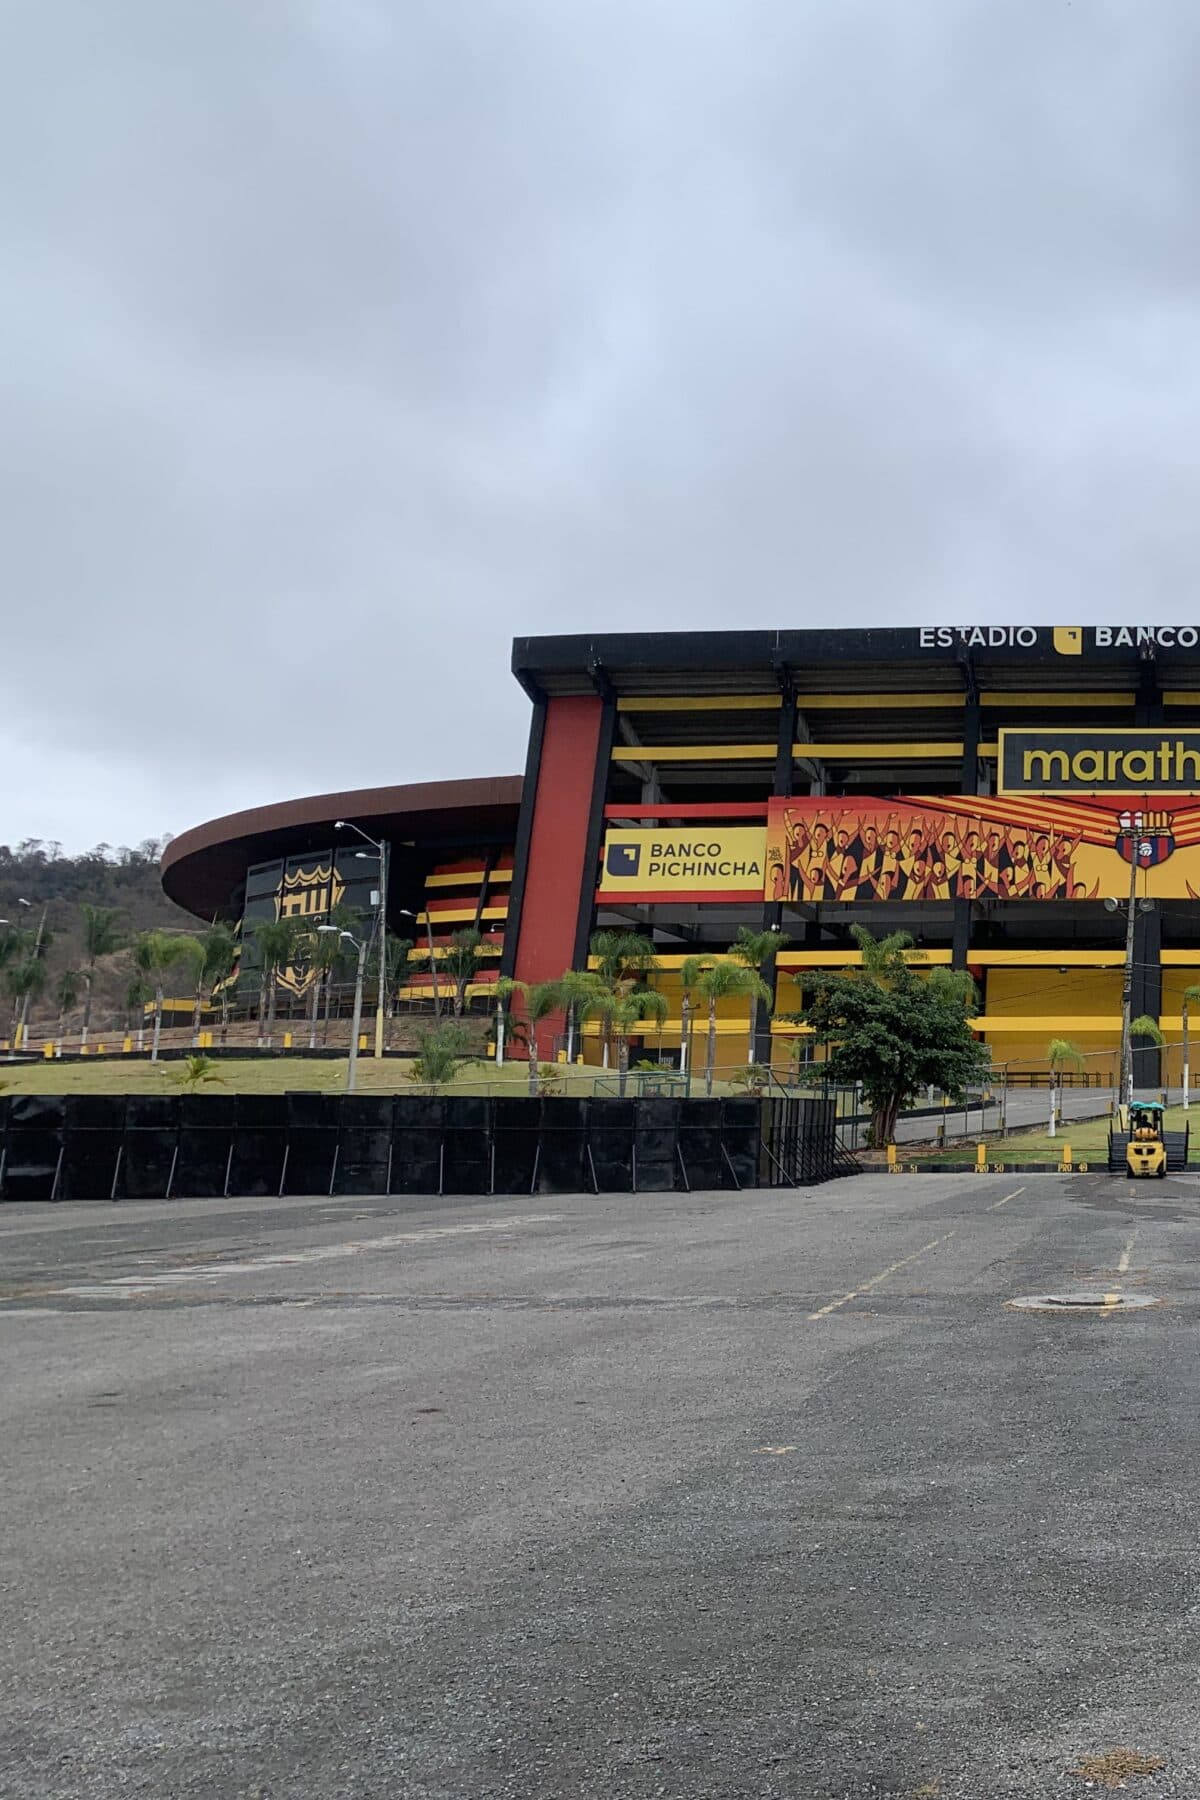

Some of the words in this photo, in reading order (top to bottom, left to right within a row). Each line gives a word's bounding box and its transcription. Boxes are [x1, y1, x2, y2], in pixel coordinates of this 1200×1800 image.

[919, 626, 1038, 648] ESTADIO
[1095, 626, 1199, 647] BANCO
[650, 843, 722, 858] BANCO
[649, 861, 761, 877] PICHINCHA
